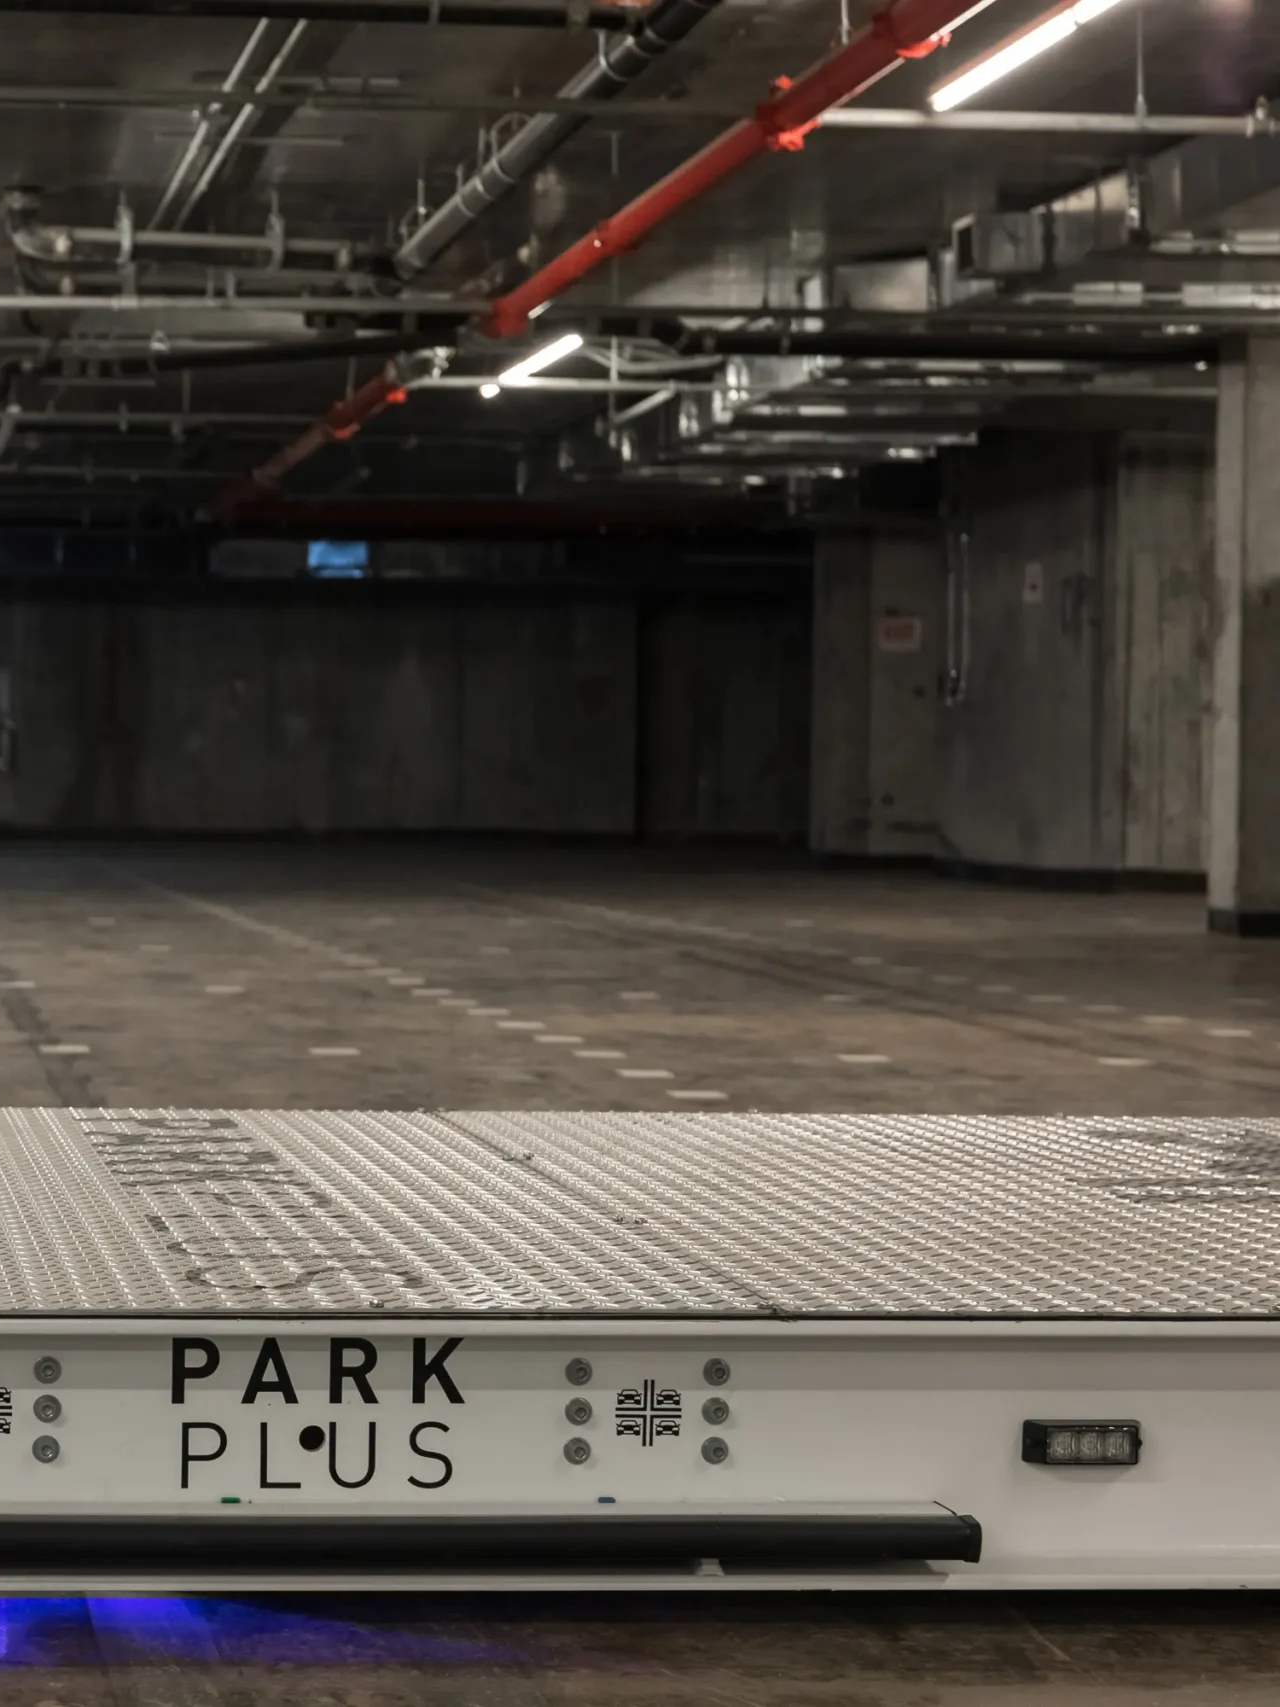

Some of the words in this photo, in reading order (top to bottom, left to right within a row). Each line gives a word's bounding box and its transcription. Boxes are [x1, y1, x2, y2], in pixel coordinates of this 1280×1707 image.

[72, 1118, 312, 1187] PARK
[126, 1190, 424, 1290] PLUS
[171, 1337, 465, 1404] PARK
[181, 1421, 453, 1489] PLUS
